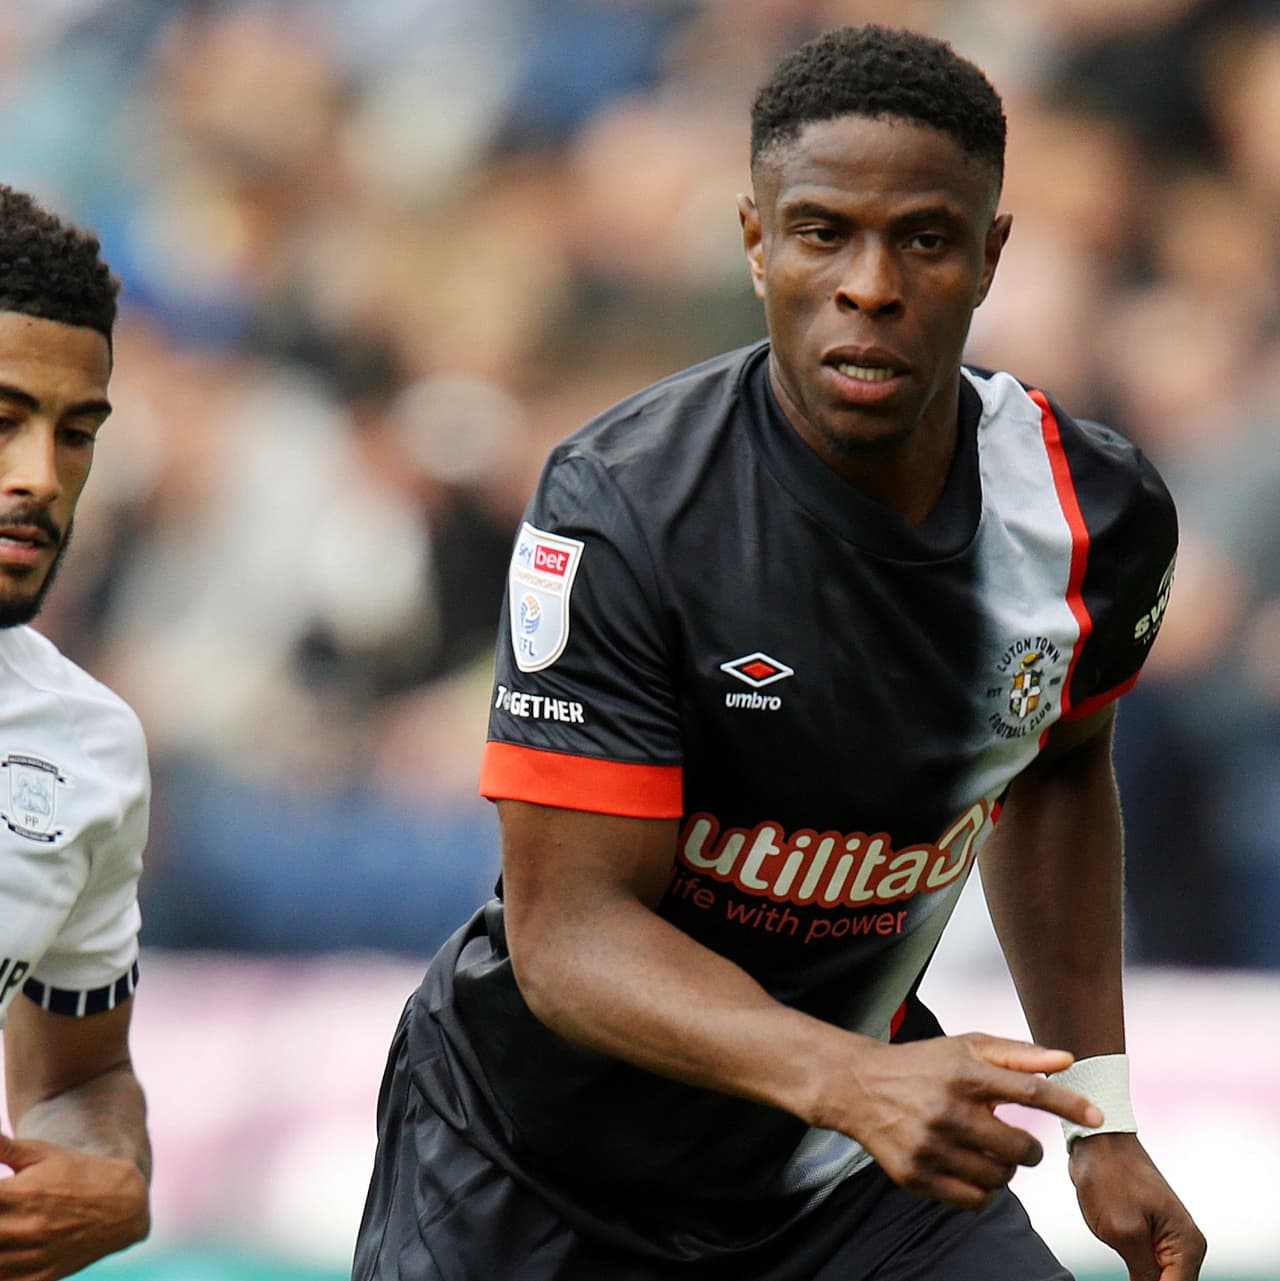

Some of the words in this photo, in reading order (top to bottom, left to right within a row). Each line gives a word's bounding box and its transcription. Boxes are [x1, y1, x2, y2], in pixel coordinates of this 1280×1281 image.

[536, 546, 566, 571] bet
[997, 638, 1032, 672] LUTON
[1035, 636, 1061, 664] TOWN
[725, 691, 782, 711] umbro
[1029, 702, 1052, 730] CLUB
[680, 815, 930, 904] utilita
[726, 900, 800, 935] with
[804, 910, 907, 944] power
